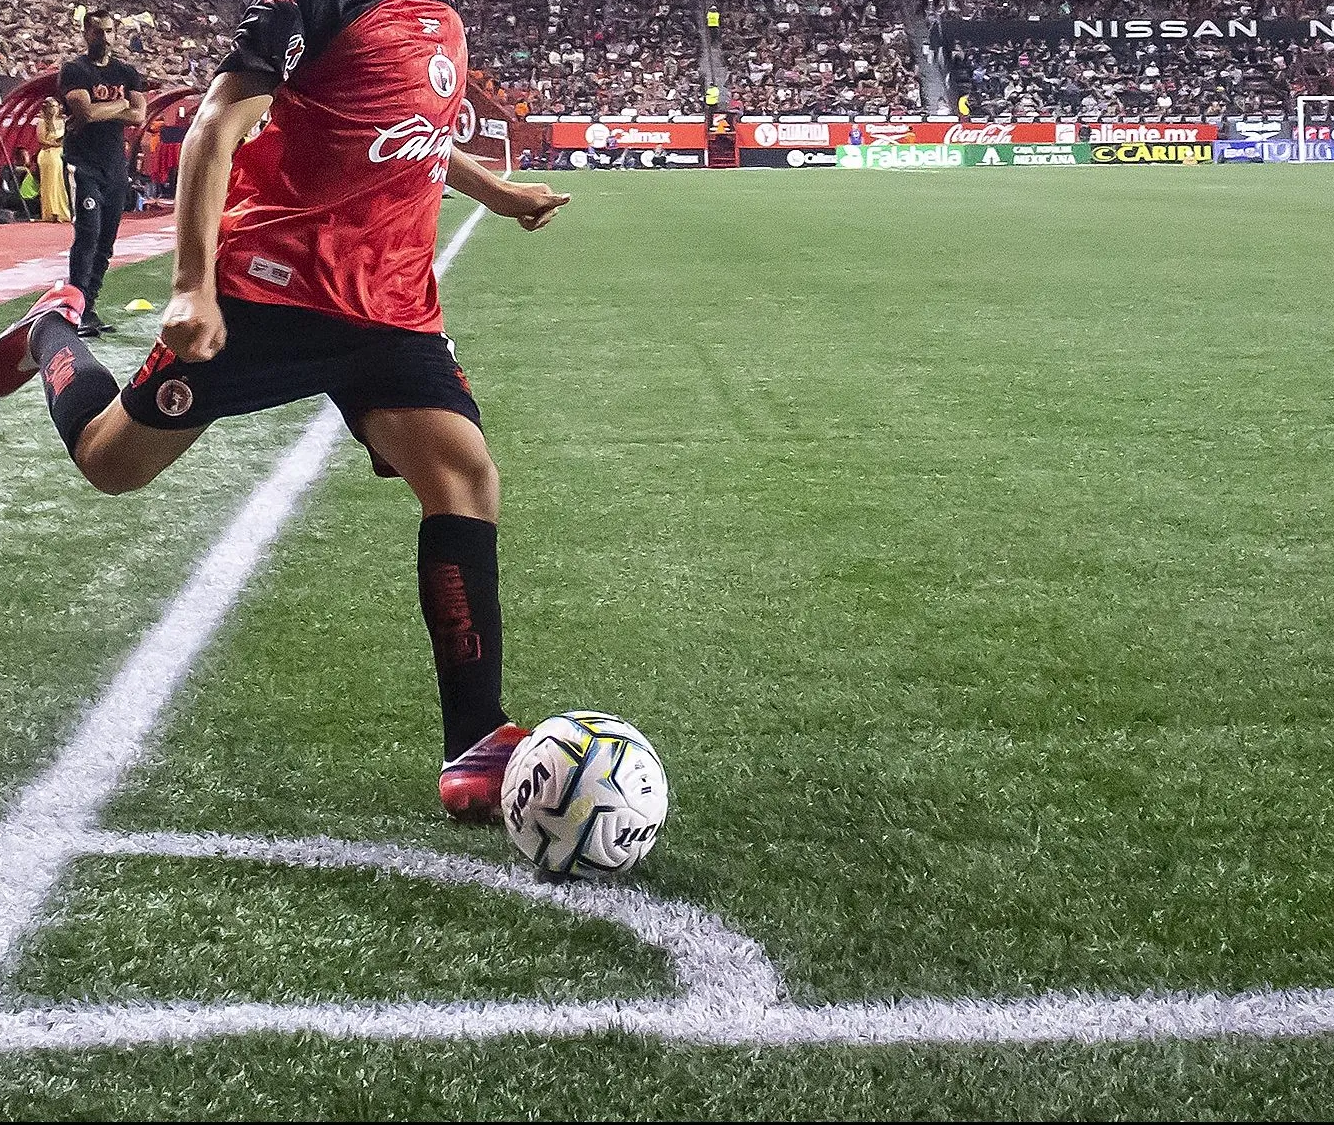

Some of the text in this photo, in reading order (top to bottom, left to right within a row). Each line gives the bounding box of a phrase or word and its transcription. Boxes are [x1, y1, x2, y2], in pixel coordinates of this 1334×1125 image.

[1074, 19, 1257, 39] NISSAN
[1088, 123, 1199, 143] aliente.mx
[867, 146, 962, 167] Falabella
